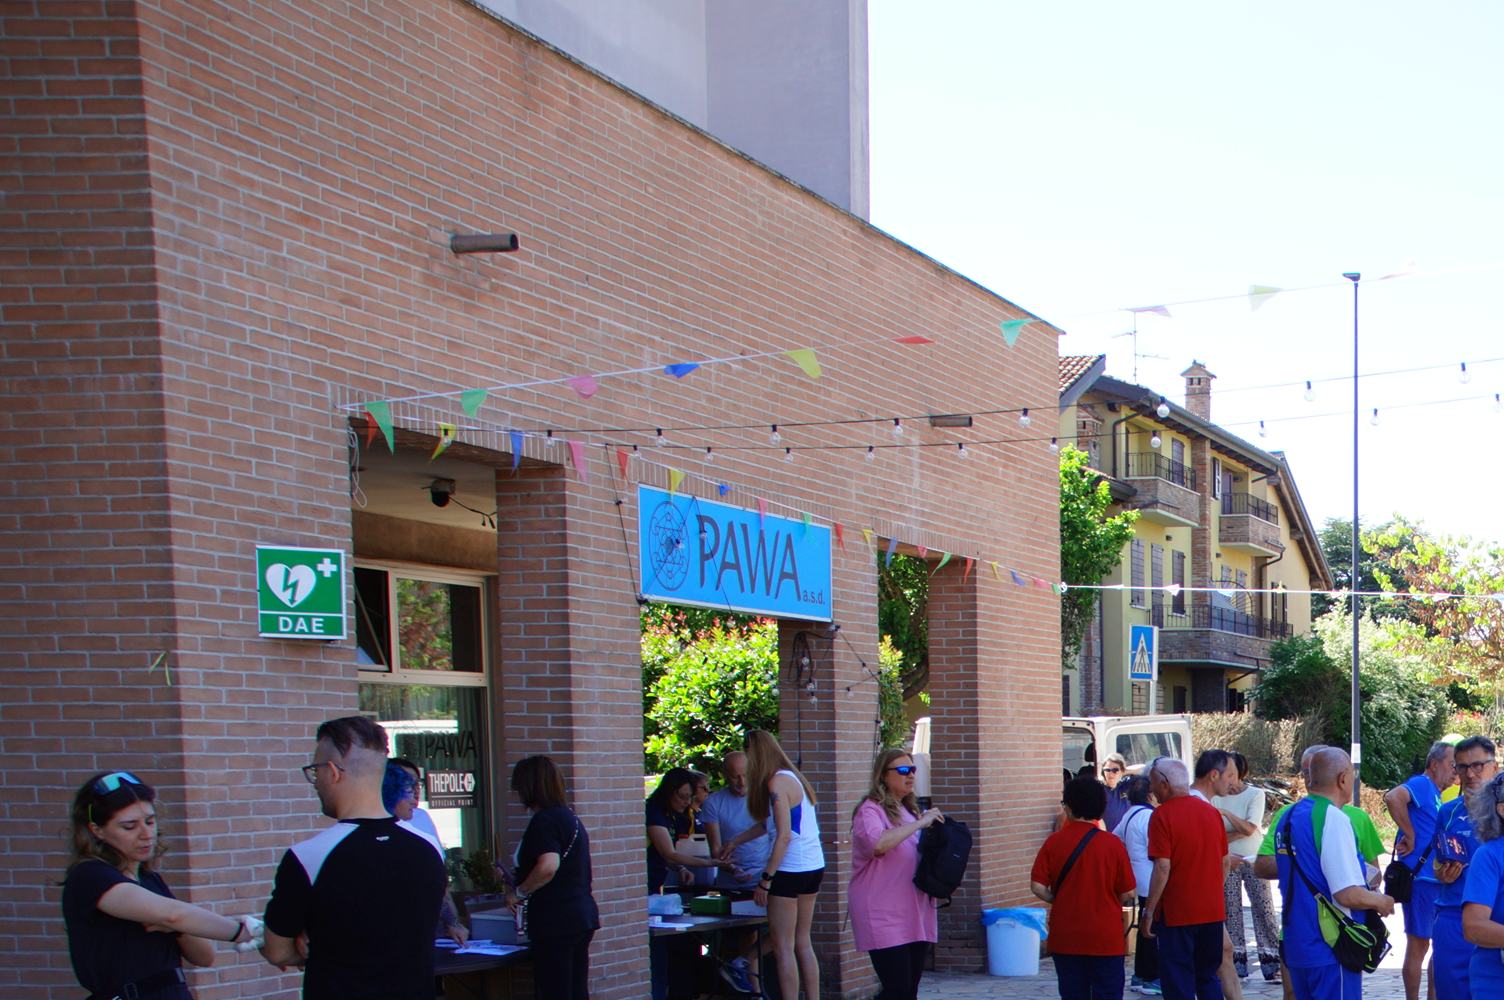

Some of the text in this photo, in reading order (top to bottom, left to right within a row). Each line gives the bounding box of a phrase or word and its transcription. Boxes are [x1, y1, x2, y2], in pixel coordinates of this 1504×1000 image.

[696, 514, 802, 602] PAWA
[803, 591, 826, 605] a.s.d.
[278, 616, 325, 633] DAE
[425, 731, 477, 759] PAWA
